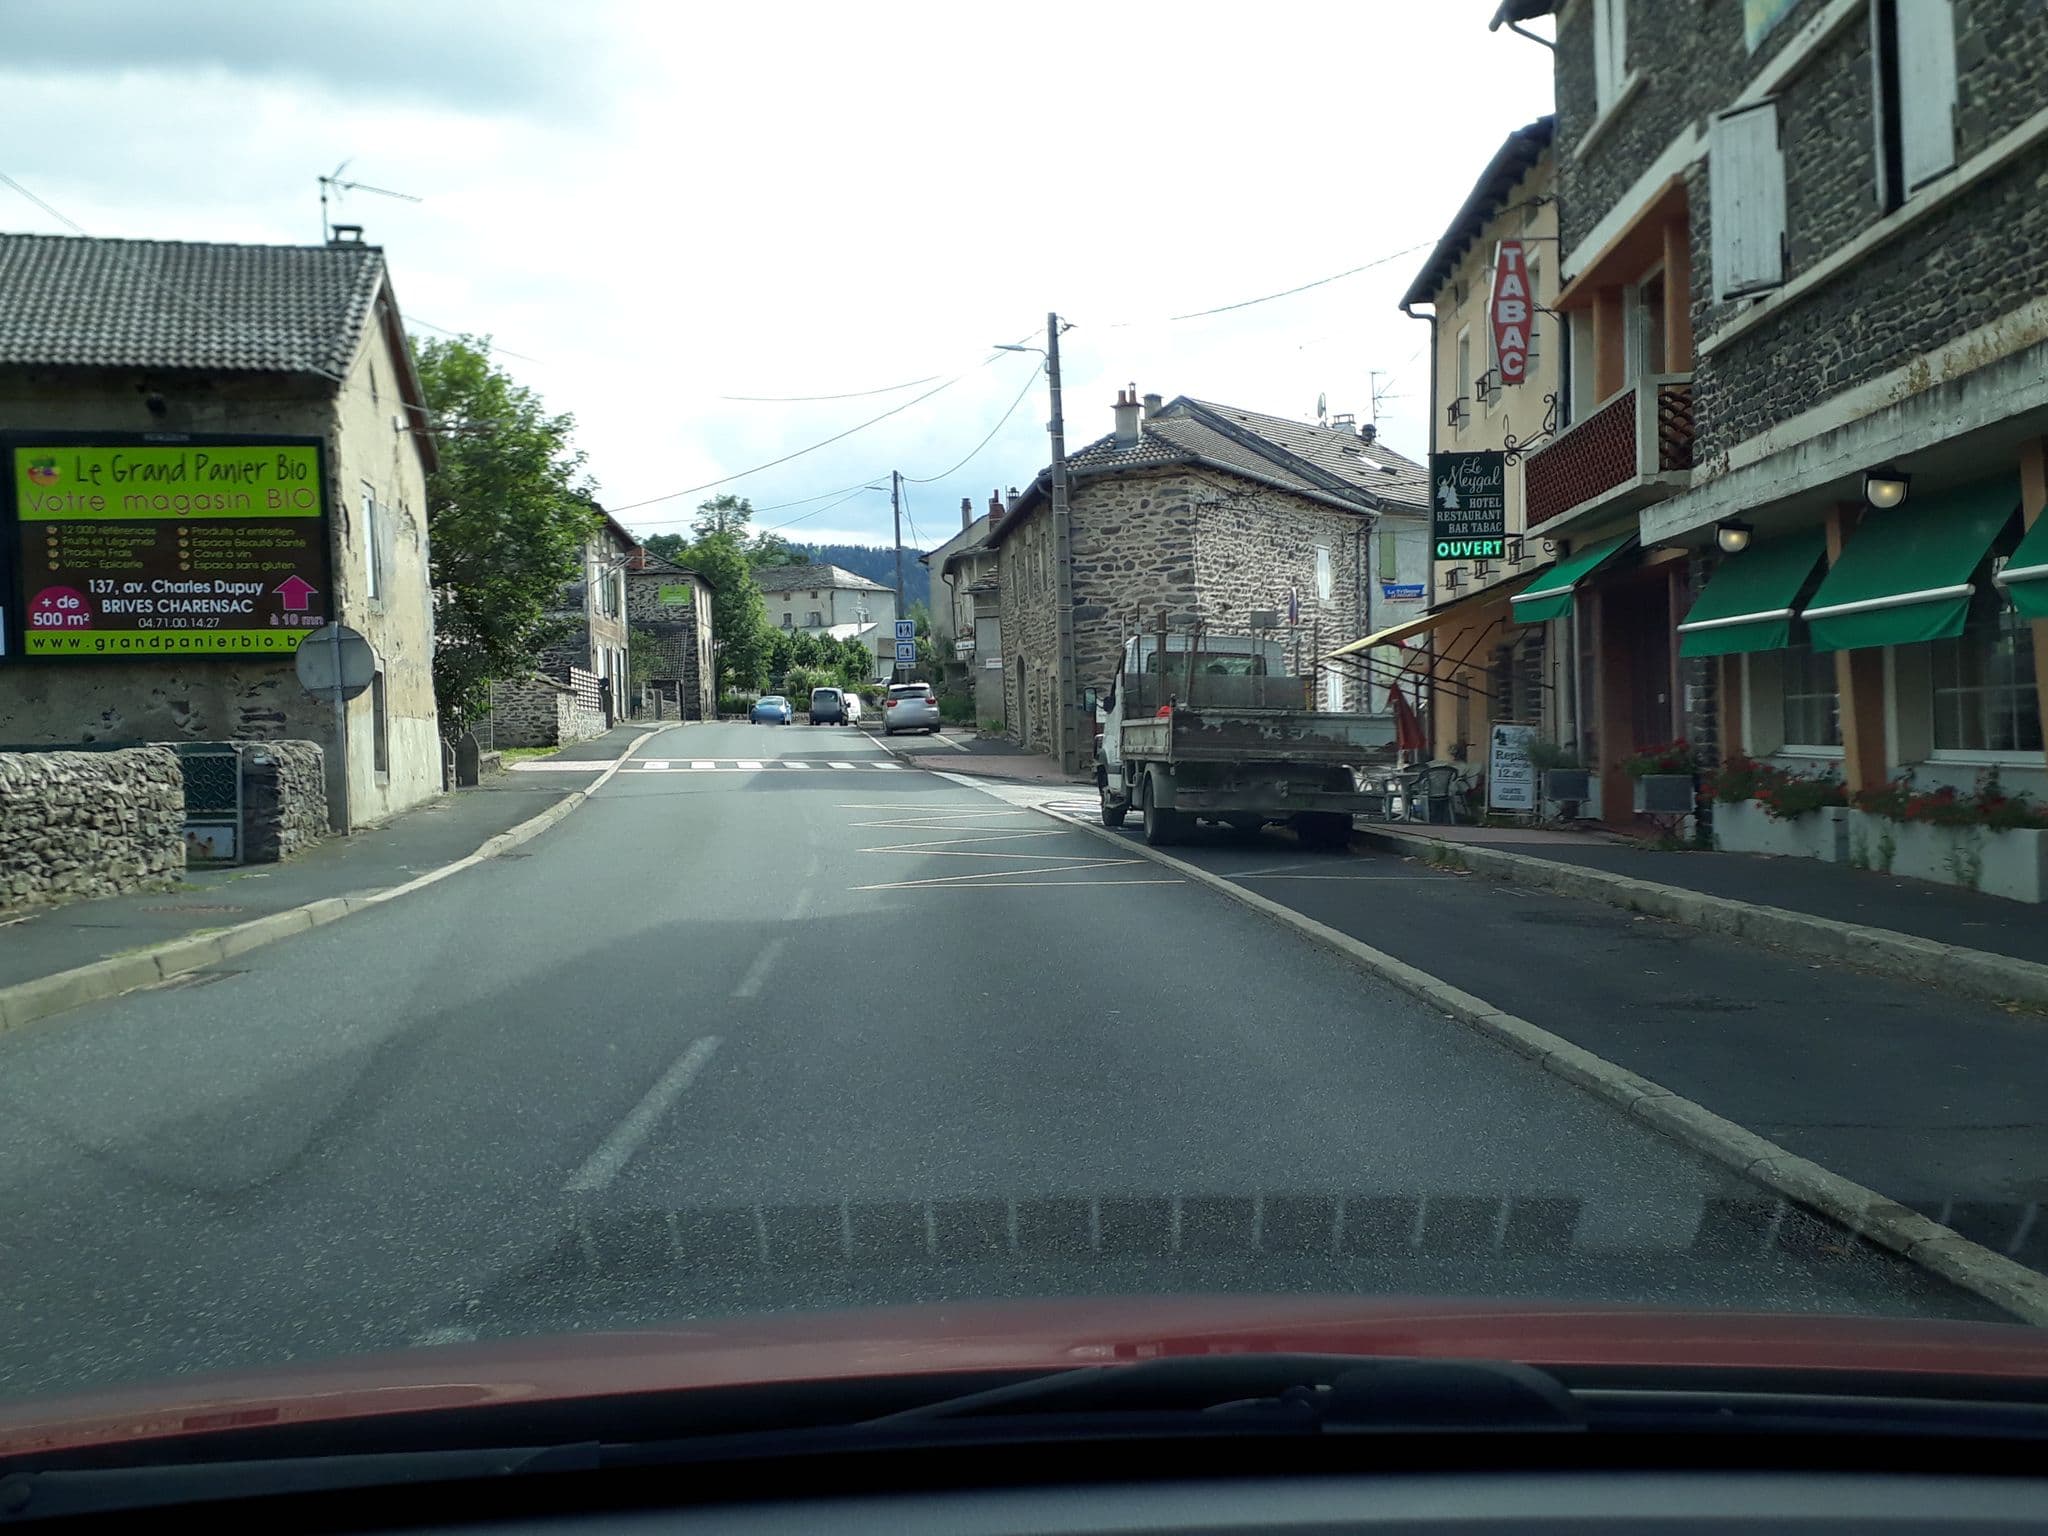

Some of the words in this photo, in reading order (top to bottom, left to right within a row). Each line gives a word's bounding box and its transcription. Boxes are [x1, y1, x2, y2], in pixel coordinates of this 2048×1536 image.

[1498, 247, 1526, 375] TABAC
[76, 455, 102, 485] Le
[112, 453, 186, 484] Grand
[195, 454, 269, 484] Panier
[277, 453, 307, 480] Bio
[1463, 457, 1483, 474] Le
[1437, 466, 1502, 494] Meygal
[25, 490, 104, 511] Votre
[124, 489, 250, 515] magasin
[267, 487, 315, 508] BIO
[1469, 497, 1502, 508] HOTEL
[1437, 510, 1502, 521] RESTAURANT
[191, 527, 233, 536] Produits
[1448, 522, 1468, 533] BAR
[1471, 521, 1503, 533] TABAC
[62, 536, 90, 545] Fruits
[92, 537, 103, 545] et
[105, 537, 156, 548] Légumes
[191, 537, 232, 547] Espace
[233, 538, 273, 547] Beauté
[275, 538, 307, 547] Santé
[1437, 541, 1502, 556] OUVERT
[63, 548, 106, 557] Produits
[108, 548, 132, 557] Frais
[193, 549, 223, 558] Cave
[237, 549, 251, 558] vin
[63, 560, 89, 568] Vrac
[194, 560, 233, 570] Espace
[235, 561, 259, 569] sans
[261, 560, 297, 571] gluten
[89, 579, 119, 595] 137,
[123, 582, 147, 593] av.
[151, 579, 211, 593] Charles
[214, 580, 264, 595] Dupuy
[42, 598, 52, 607] +
[56, 595, 80, 608] de
[102, 599, 153, 613] BRIVES
[157, 599, 254, 613] CHARENSAC
[33, 612, 63, 625] 500
[138, 617, 219, 628] 04.71.00.14.27
[270, 612, 279, 625] à
[282, 613, 298, 625] 10
[301, 616, 324, 625] mn
[33, 635, 303, 651] www.grandpanierbio.b
